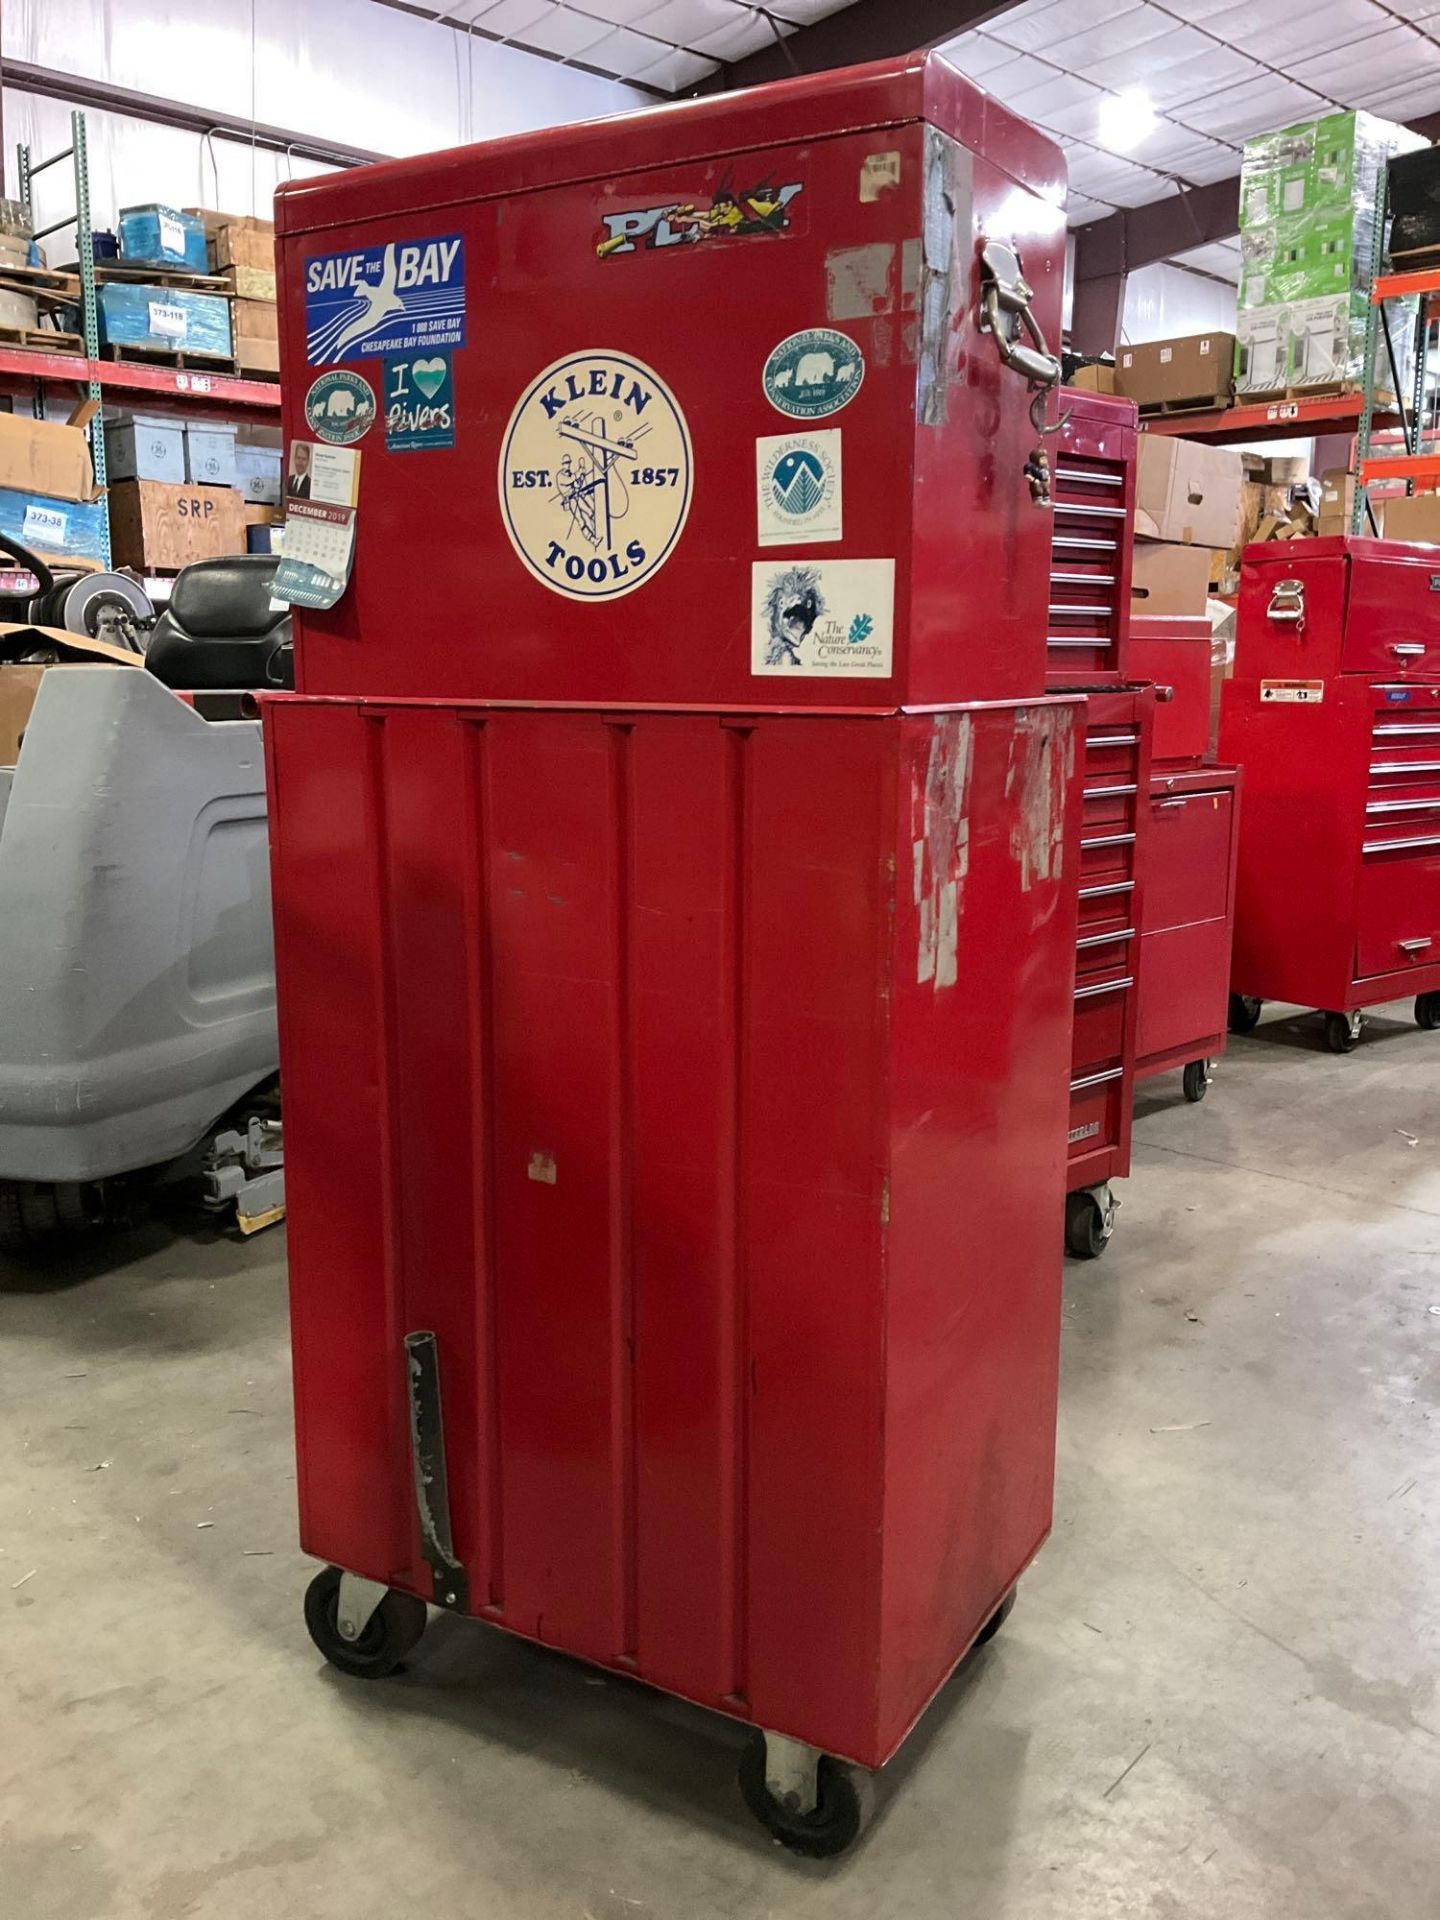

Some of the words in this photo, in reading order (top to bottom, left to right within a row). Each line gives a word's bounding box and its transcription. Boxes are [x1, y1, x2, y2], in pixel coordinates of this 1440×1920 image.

[307, 254, 366, 293] SAVE
[366, 260, 381, 274] THE
[397, 239, 462, 288] BAY
[429, 320, 445, 332] SAVE
[447, 318, 461, 329] BAY
[361, 338, 403, 353] CHESAPEAKE
[404, 336, 417, 348] BAY
[418, 331, 461, 346] FOUNDATION
[772, 332, 813, 360] NATIONAL
[814, 331, 840, 344] PARKS
[840, 340, 858, 356] AND
[390, 363, 409, 398] I
[539, 369, 653, 419] KLEIN
[761, 438, 821, 481] WILDERNESS
[512, 470, 552, 489] EST.
[630, 467, 680, 488] 1857
[762, 483, 774, 510] THE
[178, 498, 214, 518] SRP
[288, 502, 327, 519] DECEMBER
[327, 511, 347, 523] 2019
[31, 512, 63, 527] 373-38
[545, 539, 647, 583] TOOLS
[813, 631, 846, 645] Nature
[825, 620, 844, 634] The
[818, 646, 878, 659] Conservancy
